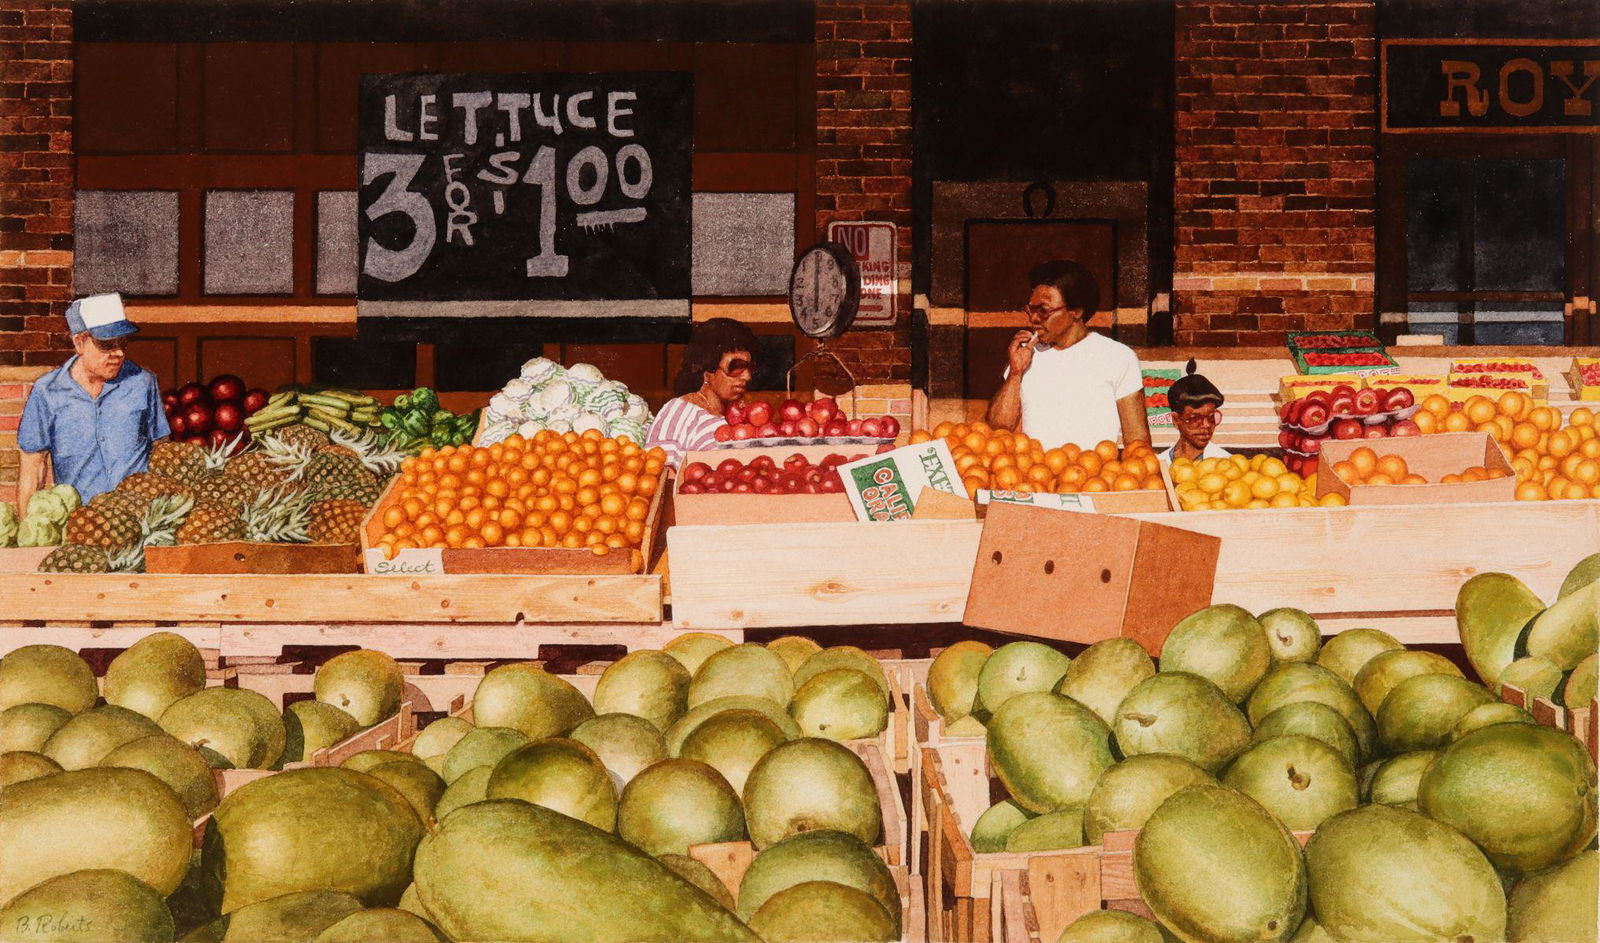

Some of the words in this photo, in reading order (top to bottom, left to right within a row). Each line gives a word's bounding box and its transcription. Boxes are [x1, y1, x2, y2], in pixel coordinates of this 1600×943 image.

[1440, 58, 1600, 117] ROY
[384, 90, 637, 145] LETTUCE
[363, 152, 437, 282] 3
[443, 153, 478, 246] FOR
[837, 226, 867, 257] NO
[919, 447, 955, 496] EXE
[374, 560, 436, 574] Select
[35, 911, 93, 935] Roberts
